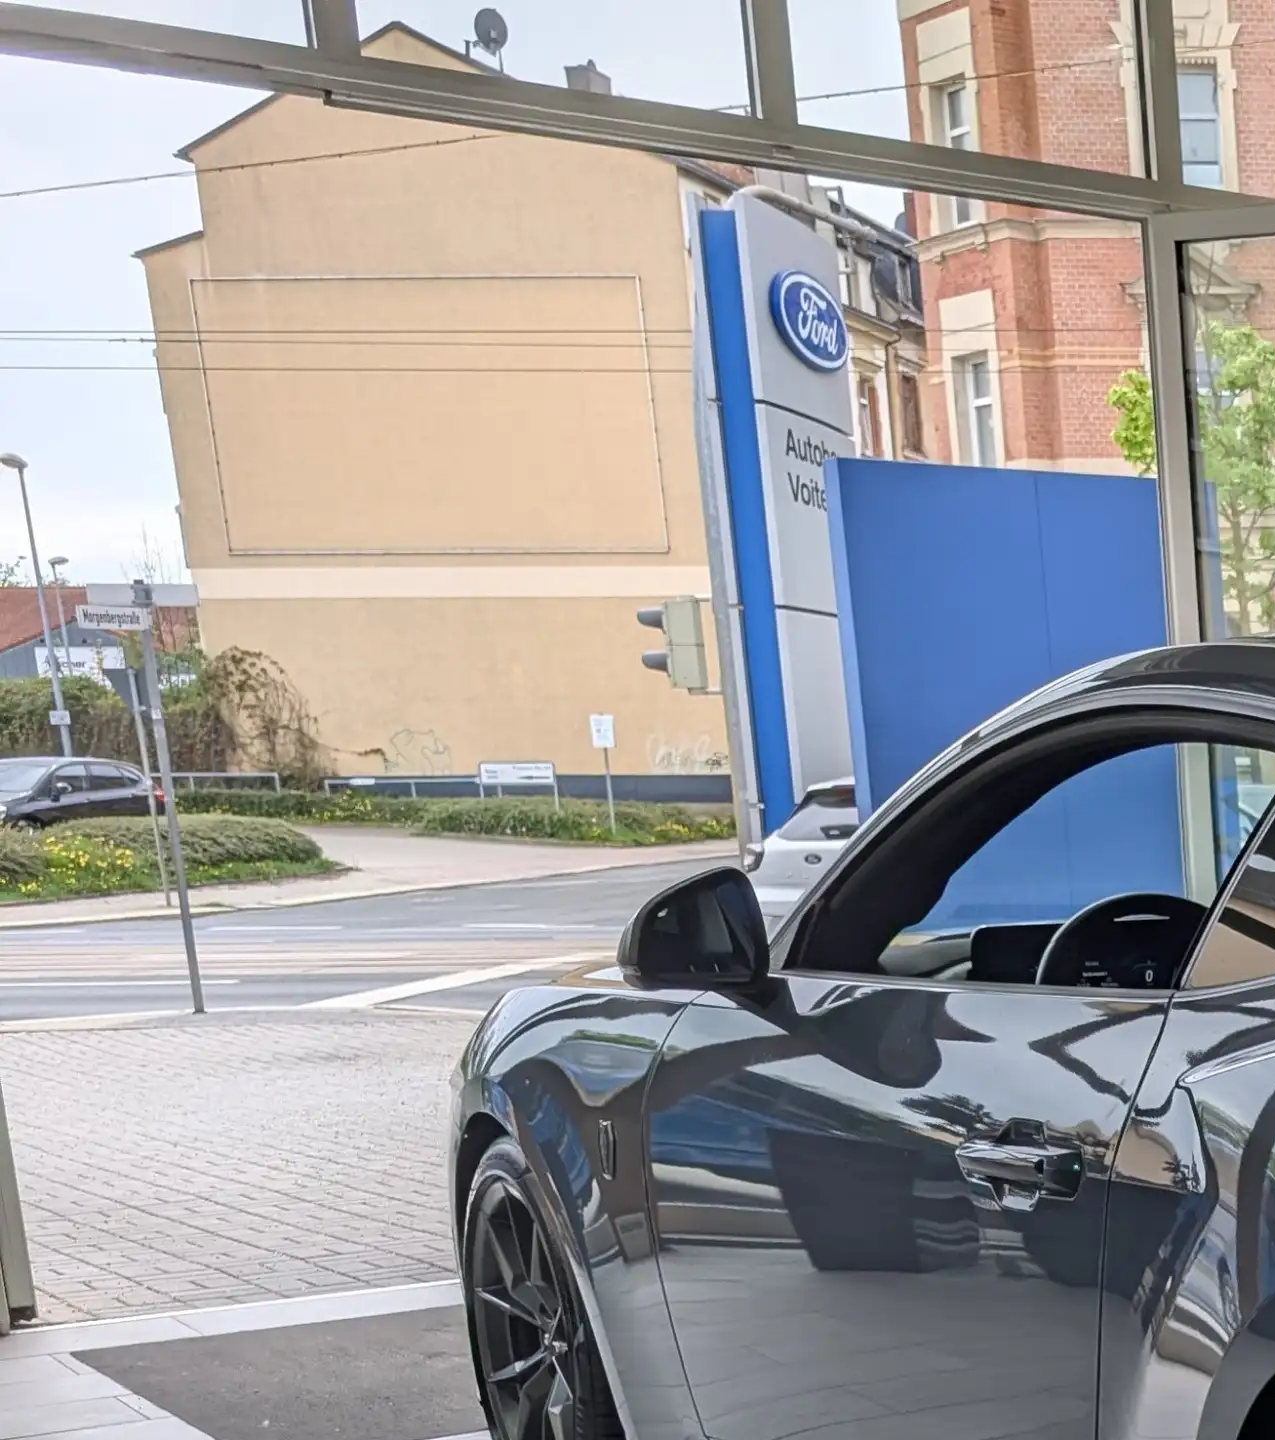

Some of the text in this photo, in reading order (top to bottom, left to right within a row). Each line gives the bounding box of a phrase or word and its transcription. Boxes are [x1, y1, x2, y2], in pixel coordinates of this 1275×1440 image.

[798, 286, 838, 356] Ford
[786, 428, 836, 467] Autoh
[82, 608, 141, 628] Morgenbergstraße
